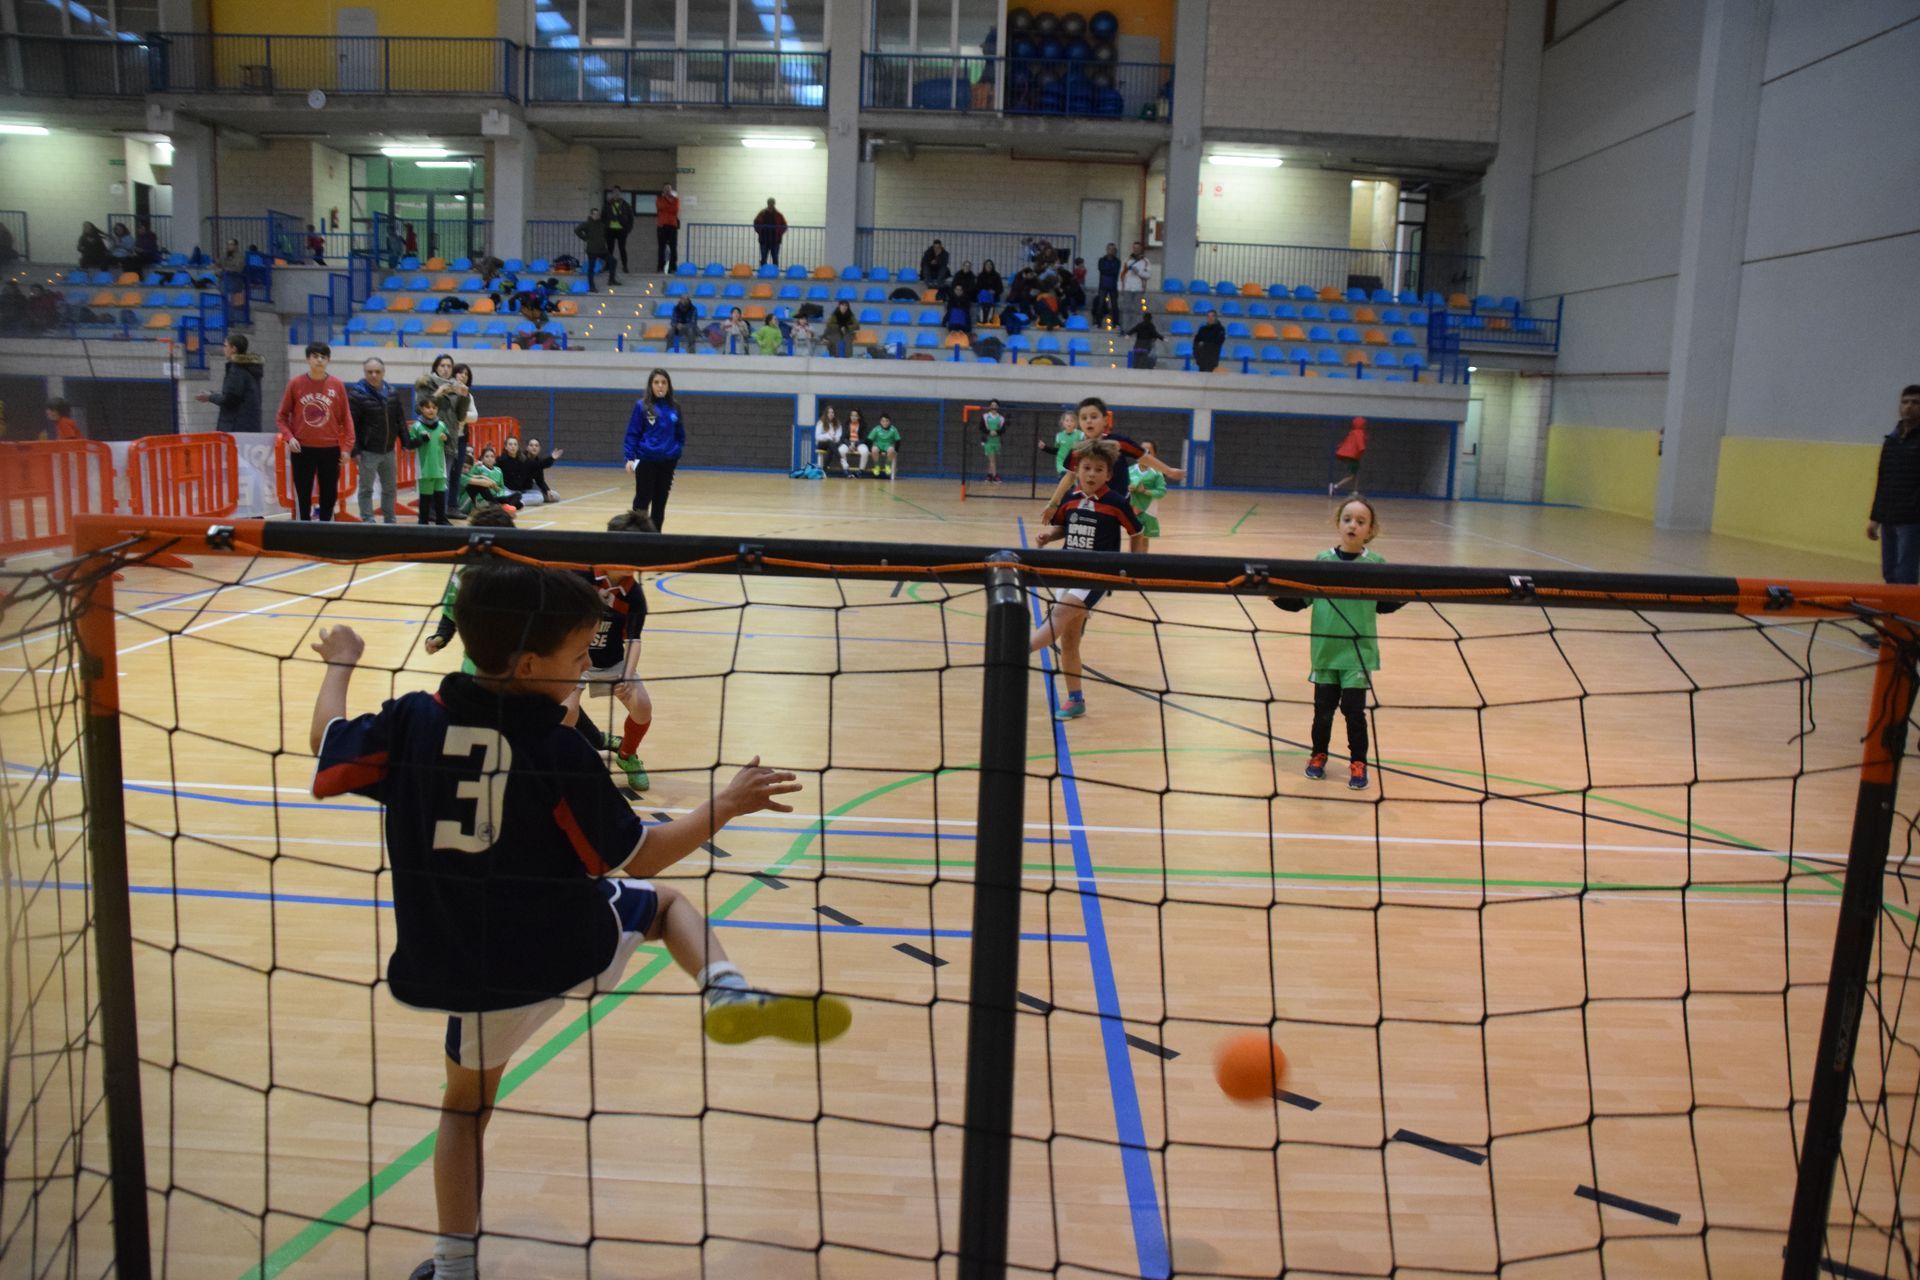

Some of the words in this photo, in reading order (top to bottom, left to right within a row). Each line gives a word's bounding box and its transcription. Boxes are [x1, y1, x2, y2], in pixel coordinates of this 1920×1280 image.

[1067, 534, 1095, 549] BASE
[590, 633, 608, 647] SE
[433, 725, 512, 853] 3
